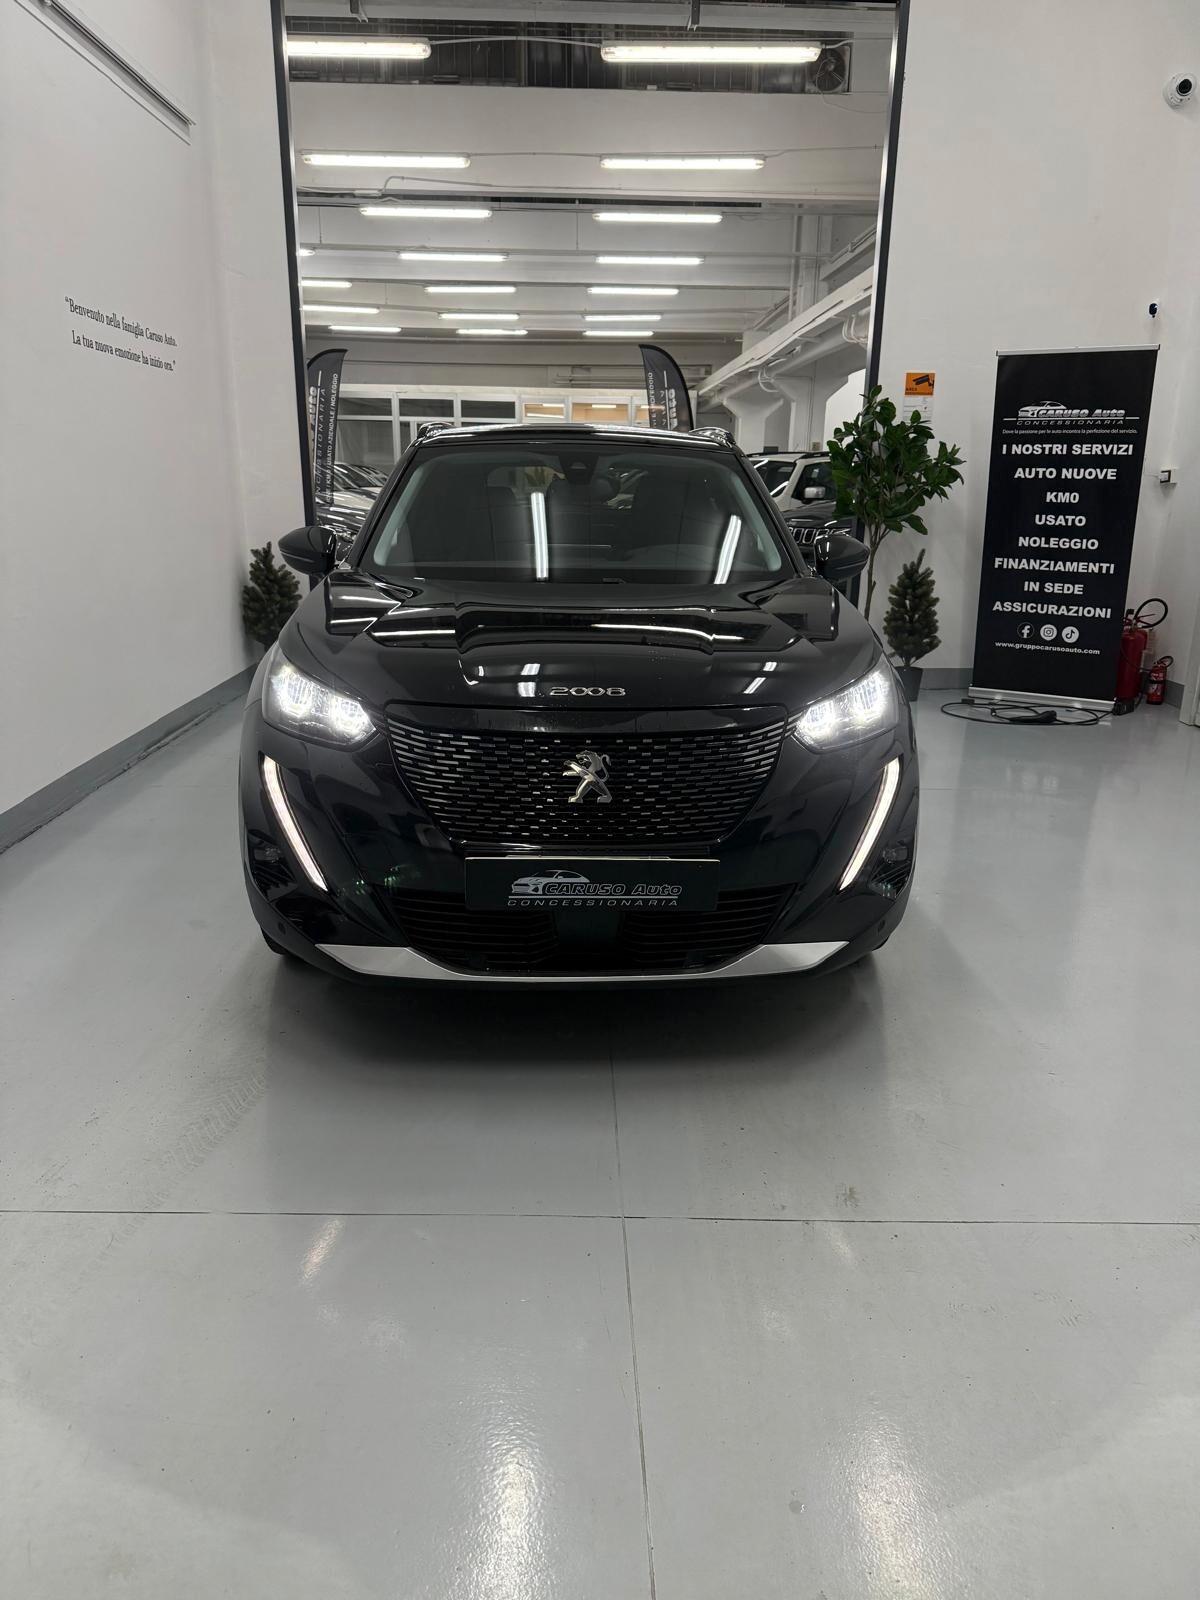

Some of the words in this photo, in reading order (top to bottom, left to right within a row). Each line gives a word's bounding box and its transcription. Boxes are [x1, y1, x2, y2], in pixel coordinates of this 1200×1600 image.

[64, 296, 105, 324] “Benvenuto
[105, 312, 121, 329] nella
[121, 316, 144, 339] famiglia
[145, 327, 163, 344] Caruso
[71, 329, 82, 346] La
[82, 334, 94, 349] tua
[95, 340, 114, 355] nuova
[114, 348, 141, 363] emozione
[141, 350, 149, 365] ha
[149, 354, 163, 369] inizio
[331, 373, 339, 407] NOLEGGIO
[1038, 408, 1089, 418] CARUSO
[1092, 408, 1126, 417] Auto
[328, 411, 336, 445] AZIENDALE
[1002, 444, 1007, 455] I
[1011, 444, 1067, 455] NOSTRI
[1071, 444, 1133, 455] SERVIZI
[1014, 467, 1057, 479] AUTO
[1061, 468, 1117, 479] NUOVE
[1045, 491, 1080, 503] KM0
[1035, 514, 1087, 526] USATO
[1018, 536, 1099, 550] NOLEGGIO
[994, 557, 1115, 574] FINANZIAMENTI
[1023, 581, 1040, 592] IN
[1044, 582, 1084, 595] SEDE
[992, 601, 1112, 618] ASSICURAZIONI
[995, 641, 1100, 654] www.gruppocarusoauto.com
[549, 686, 626, 696] 2008
[545, 883, 626, 895] CARUSO
[631, 883, 682, 896] Auto
